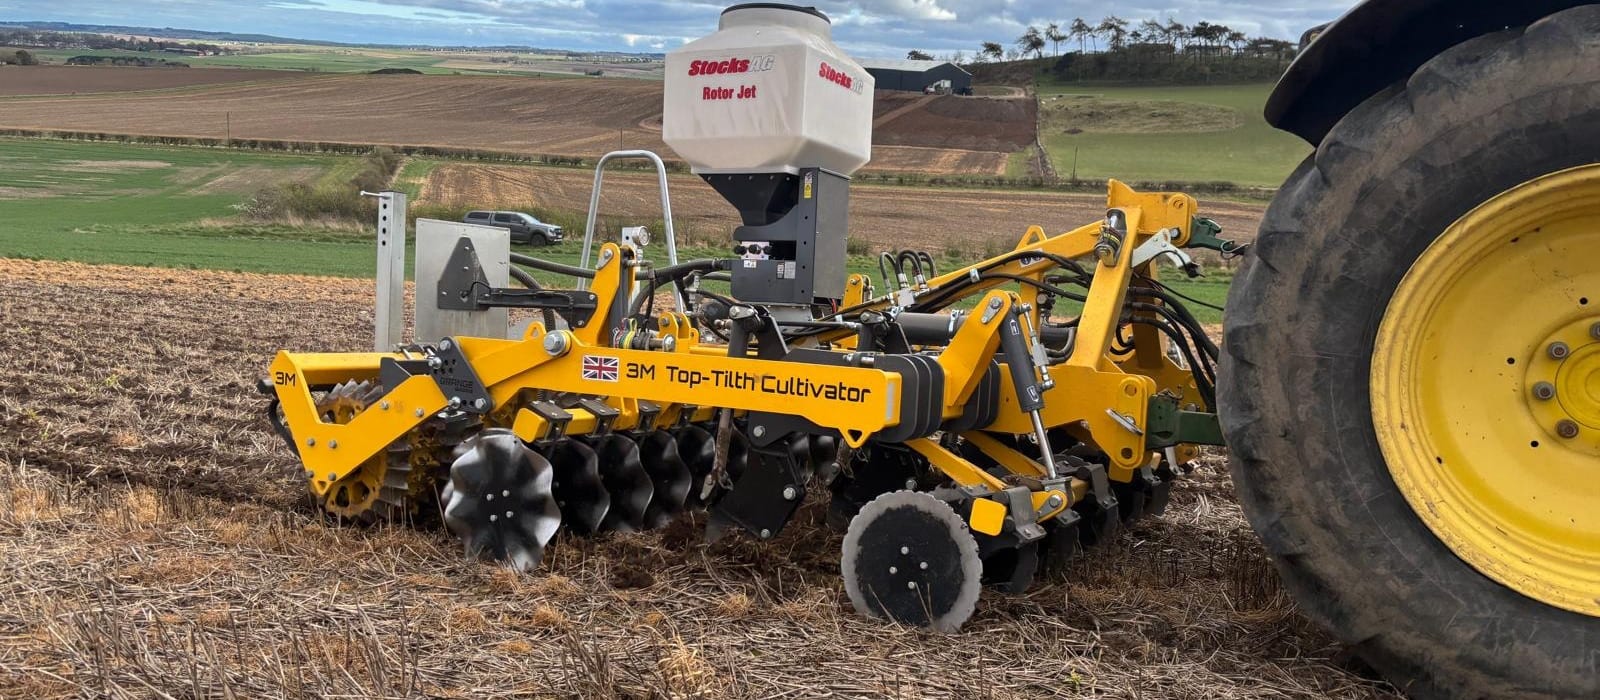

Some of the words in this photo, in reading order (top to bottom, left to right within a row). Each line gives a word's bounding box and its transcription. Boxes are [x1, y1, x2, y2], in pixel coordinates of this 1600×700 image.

[703, 86, 734, 100] Rotor
[737, 85, 756, 99] Jet
[275, 371, 296, 387] 3M
[626, 362, 656, 380] 3M
[666, 365, 755, 391] Top-Tilth
[761, 375, 872, 403] Cultivator
